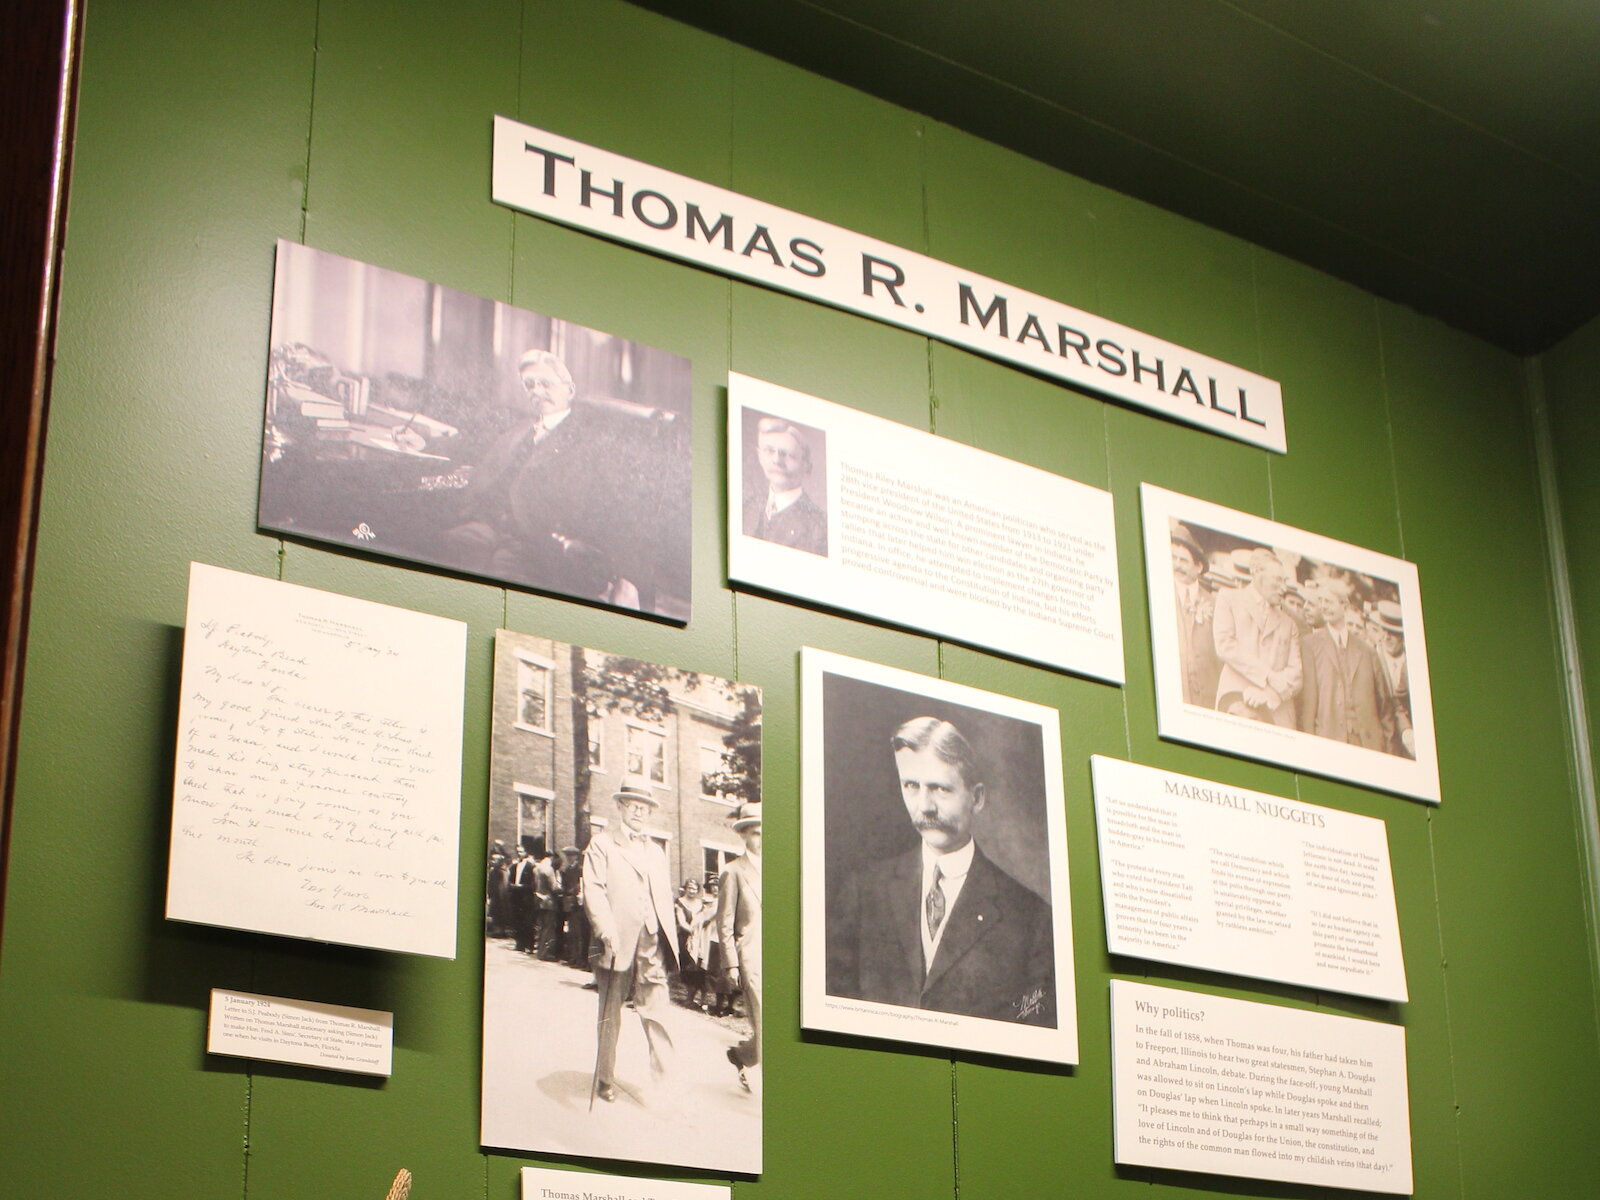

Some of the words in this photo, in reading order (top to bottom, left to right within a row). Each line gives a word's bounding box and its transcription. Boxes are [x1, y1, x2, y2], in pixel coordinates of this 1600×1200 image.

[525, 142, 826, 278] THOMAS
[863, 254, 925, 314] R.
[960, 284, 1266, 429] MARSHALL
[1165, 780, 1251, 812] MARSHALL
[1256, 801, 1326, 829] NUGGETS
[1135, 1000, 1160, 1018] Why
[1163, 1006, 1205, 1022] politics?
[1136, 1024, 1144, 1034] In
[1146, 1026, 1158, 1036] the
[1160, 1028, 1173, 1038] fall
[1174, 1031, 1182, 1040] of
[1204, 1036, 1225, 1046] when
[1226, 1038, 1255, 1051] Thomas
[1257, 1044, 1271, 1053] was
[1290, 1048, 1302, 1058] his
[1303, 1050, 1324, 1061] father
[1324, 1053, 1338, 1063] had
[1339, 1056, 1358, 1066] taken
[1359, 1058, 1373, 1068] him
[1136, 1057, 1151, 1066] and
[1153, 1058, 1188, 1071] Abraham
[1249, 1072, 1276, 1086] During
[1276, 1076, 1288, 1086] the
[1319, 1084, 1342, 1095] young
[1342, 1085, 1373, 1097] Marshall
[1180, 1047, 1208, 1059] Illinois
[1209, 1051, 1217, 1060] to
[1218, 1052, 1235, 1062] hear
[1236, 1056, 1250, 1065] two
[1251, 1059, 1269, 1068] great
[1309, 1066, 1337, 1078] Stephan
[1348, 1071, 1376, 1084] Douglas
[1137, 1074, 1152, 1082] was
[1154, 1074, 1184, 1086] allowed
[1185, 1079, 1194, 1088] to
[1195, 1080, 1204, 1089] sit
[1217, 1082, 1250, 1095] Lincoln's
[1252, 1087, 1264, 1099] lap
[1265, 1090, 1286, 1100] while
[1287, 1092, 1316, 1105] Douglas
[1317, 1098, 1338, 1107] spoke
[1339, 1100, 1352, 1109] and
[1353, 1101, 1369, 1111] then
[1149, 1089, 1183, 1102] Douglas'
[1184, 1093, 1197, 1106] lap
[1198, 1096, 1220, 1106] when
[1221, 1098, 1249, 1110] Lincoln
[1275, 1105, 1283, 1115] In
[1284, 1106, 1301, 1117] later
[1302, 1111, 1320, 1120] years
[1322, 1112, 1352, 1123] Marshall
[1138, 1118, 1155, 1129] love
[1157, 1122, 1165, 1131] of
[1166, 1122, 1195, 1134] Lincoln
[1197, 1128, 1211, 1136] and
[1212, 1128, 1221, 1137] of
[1222, 1129, 1253, 1143] Douglas
[1254, 1133, 1265, 1142] for
[1266, 1135, 1278, 1144] the
[1305, 1139, 1317, 1149] the
[1362, 1147, 1375, 1156] and
[1150, 1105, 1178, 1117] pleases
[1193, 1110, 1200, 1119] to
[1202, 1112, 1222, 1122] think
[1224, 1114, 1238, 1124] that
[1240, 1117, 1269, 1130] perhaps
[1270, 1120, 1278, 1129] in
[1285, 1123, 1304, 1132] small
[1305, 1127, 1320, 1136] way
[1322, 1128, 1358, 1141] something
[1359, 1132, 1366, 1140] of
[1368, 1132, 1378, 1142] the
[1139, 1135, 1152, 1145] the
[1153, 1136, 1176, 1149] rights
[1177, 1140, 1186, 1148] of
[1186, 1140, 1199, 1150] the
[1200, 1144, 1232, 1154] common
[1252, 1148, 1277, 1159] flowed
[1278, 1151, 1293, 1161] into
[1294, 1155, 1306, 1165] my
[1307, 1154, 1335, 1166] childish
[541, 1189, 580, 1200] Thomas
